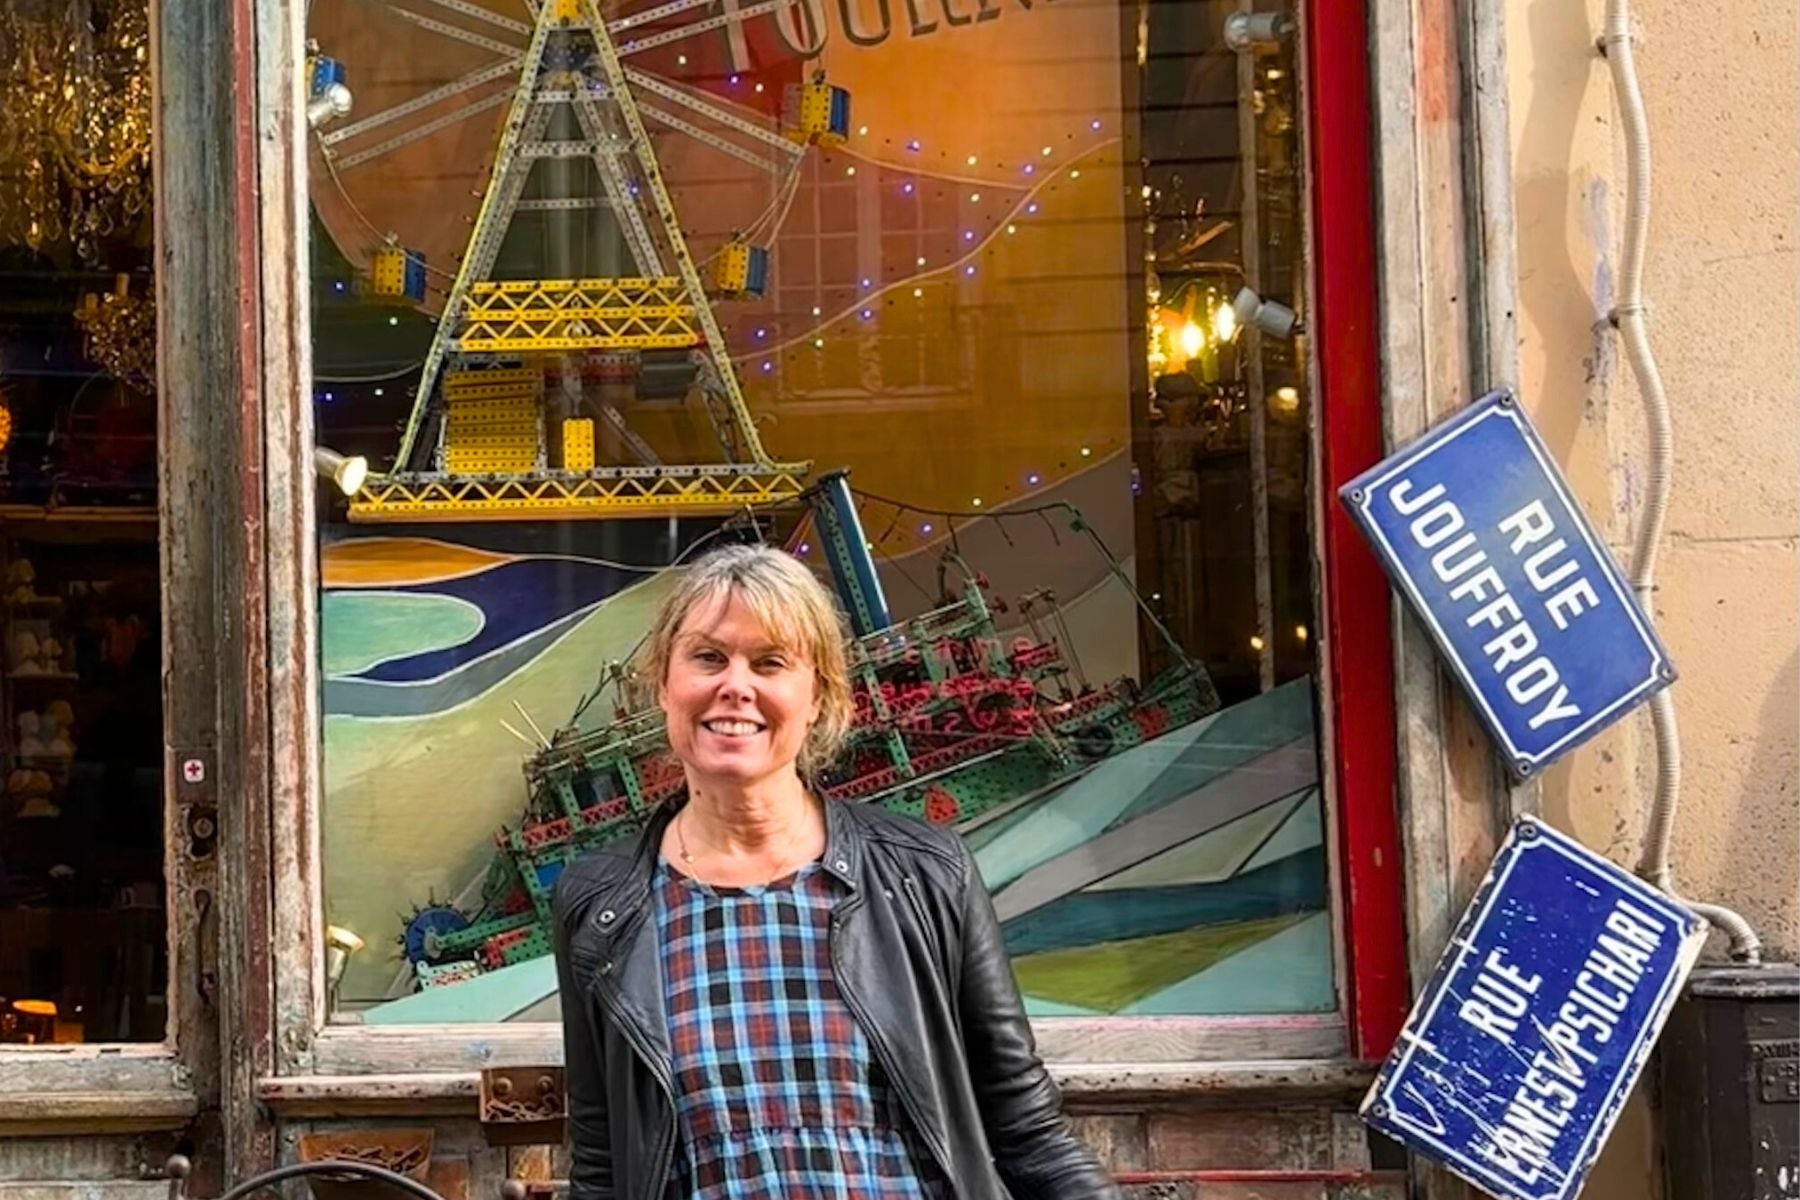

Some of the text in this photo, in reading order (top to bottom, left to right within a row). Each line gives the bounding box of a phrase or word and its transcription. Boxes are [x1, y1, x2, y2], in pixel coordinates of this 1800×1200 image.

[1389, 478, 1581, 730] JOUFFROY
[1498, 500, 1600, 631] RUE
[1458, 956, 1543, 1044] RUE
[1467, 899, 1667, 1185] ERNEST PSICHARI
